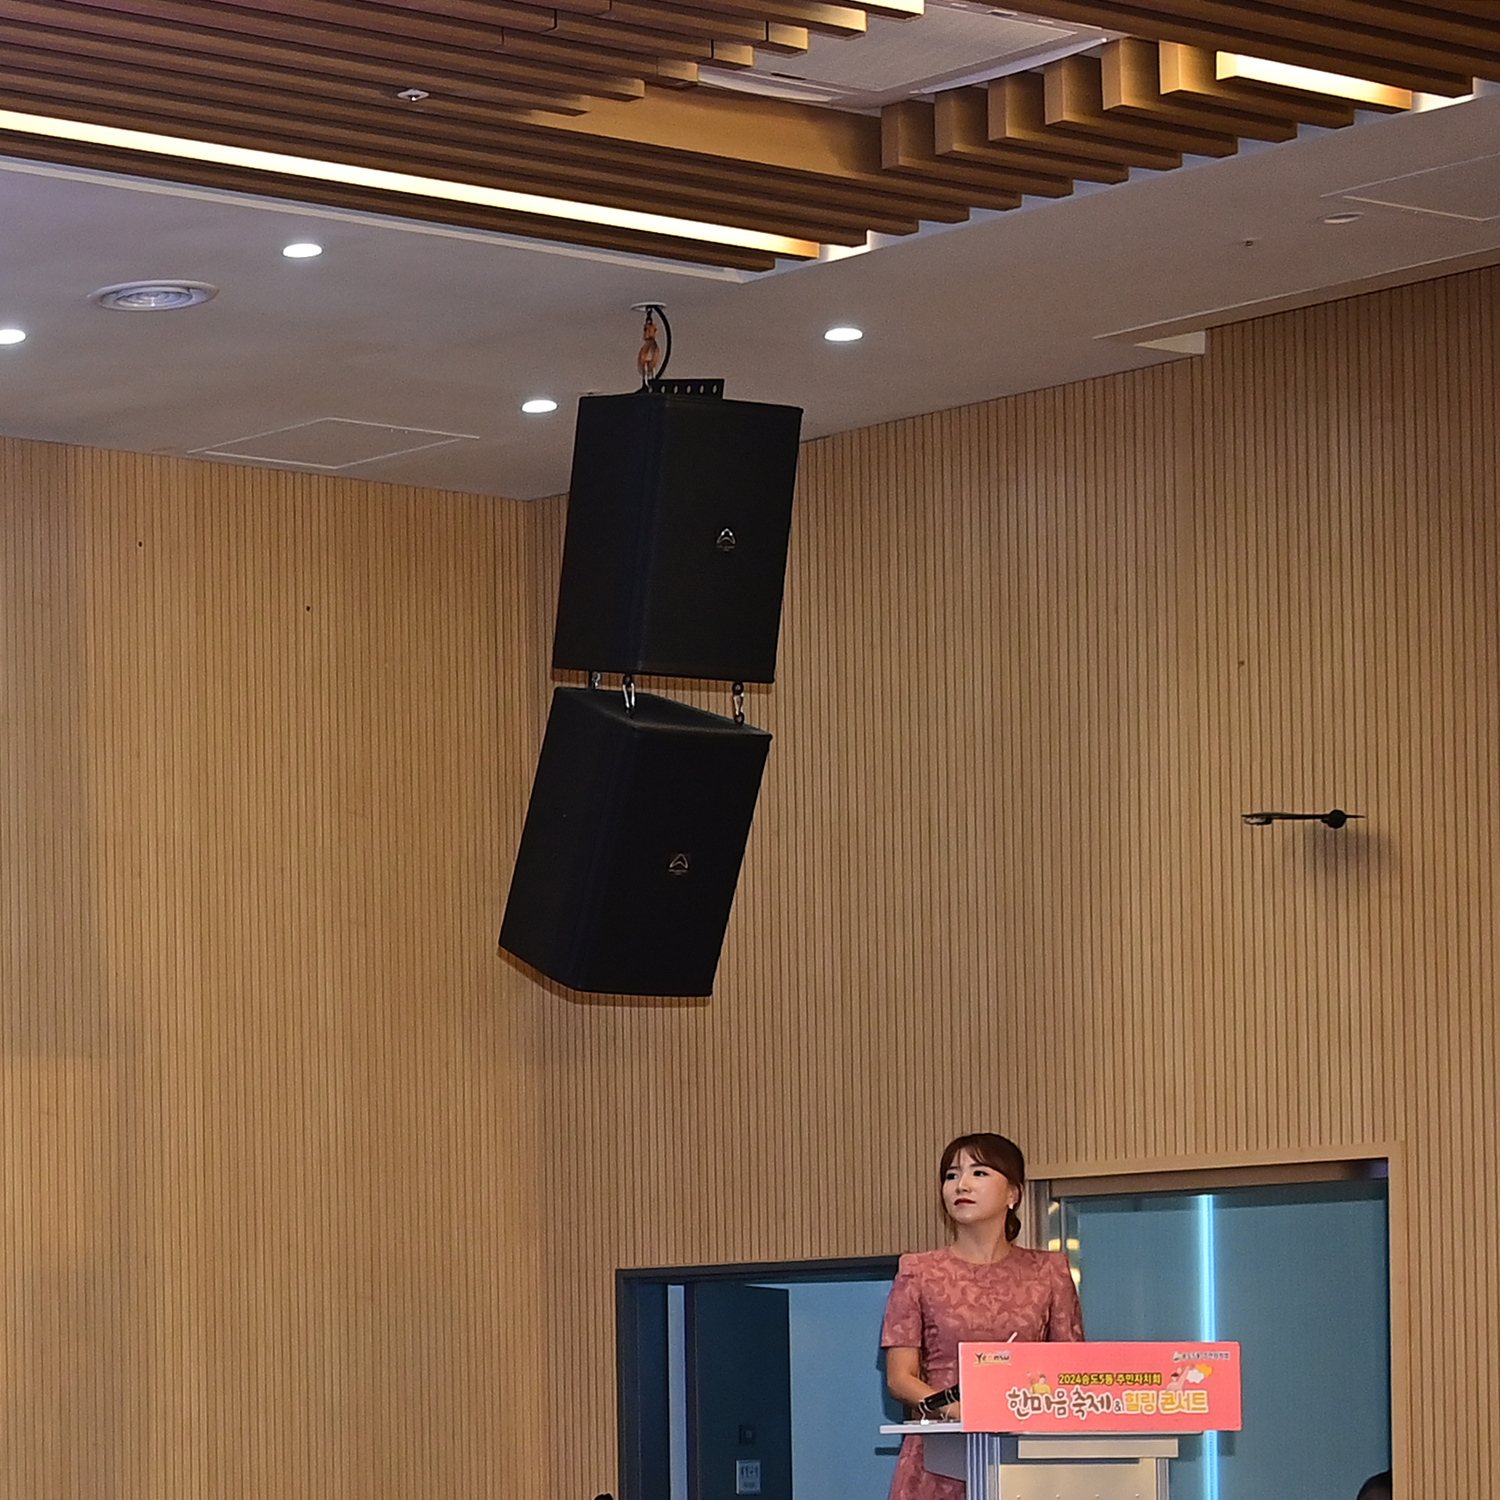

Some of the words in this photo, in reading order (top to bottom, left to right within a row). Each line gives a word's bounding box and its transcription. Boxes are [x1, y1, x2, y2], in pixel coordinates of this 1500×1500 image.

[1117, 1373, 1162, 1386] 주민자치회
[1007, 1388, 1068, 1417] 한마음
[1072, 1387, 1112, 1418] 축제
[1124, 1391, 1156, 1412] 힐링
[1160, 1391, 1208, 1412] 콘서트
